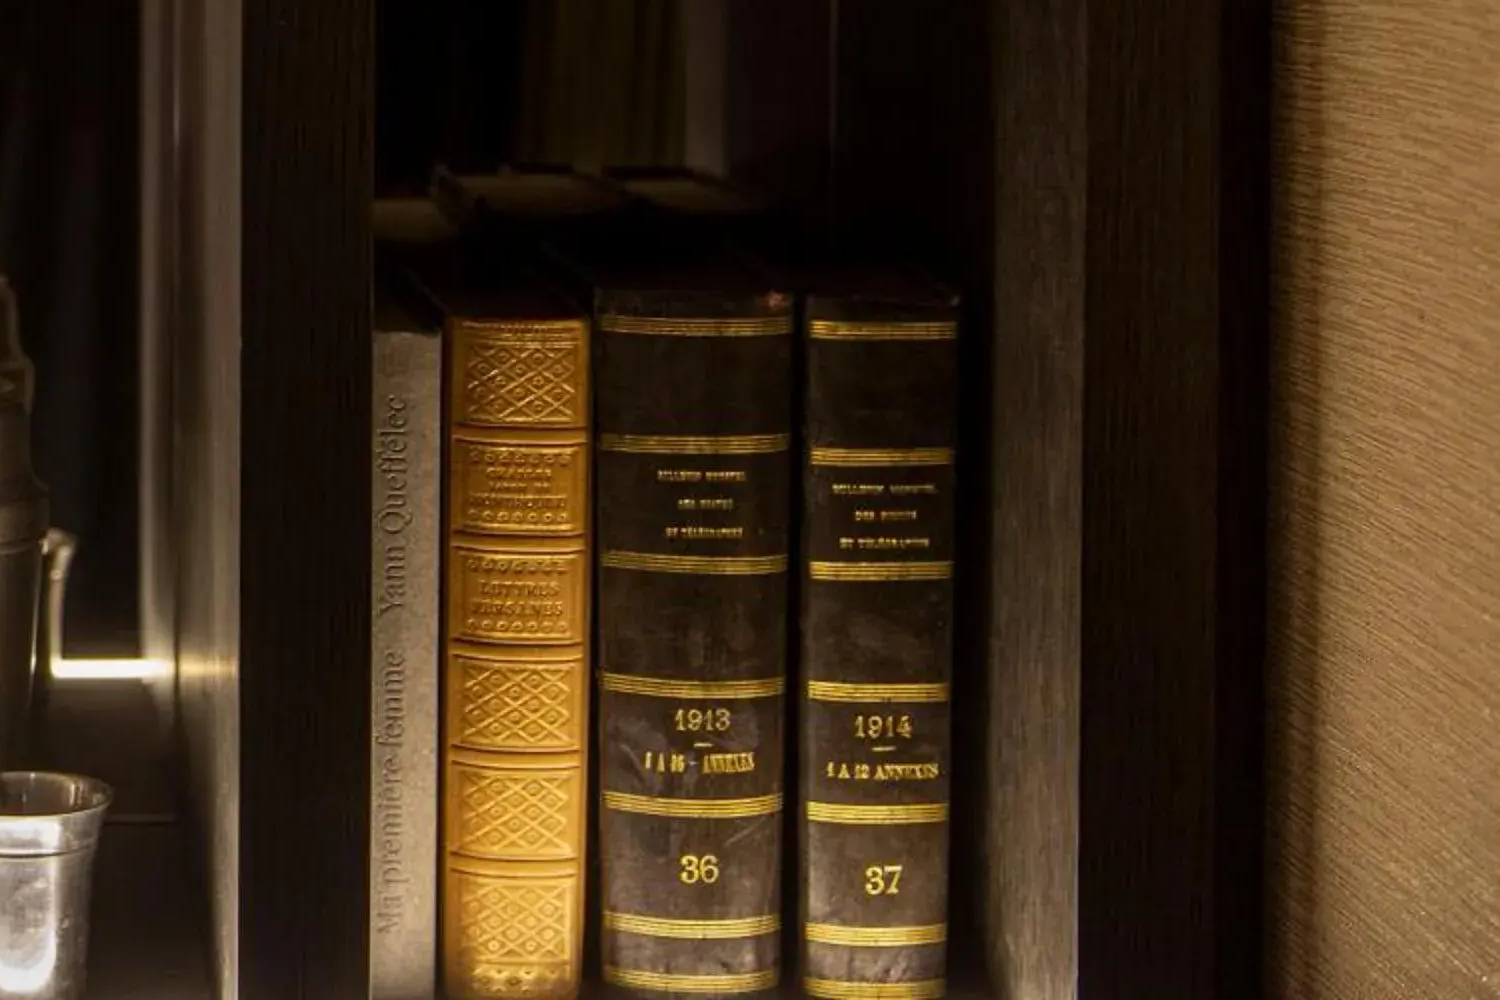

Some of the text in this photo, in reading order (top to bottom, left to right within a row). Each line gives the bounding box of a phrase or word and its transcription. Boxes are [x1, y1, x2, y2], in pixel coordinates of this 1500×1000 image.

[378, 546, 407, 617] Yann
[374, 651, 405, 749] femme
[675, 708, 731, 732] 1913
[837, 762, 851, 779] A
[680, 855, 721, 884] 36
[864, 865, 903, 896] 37
